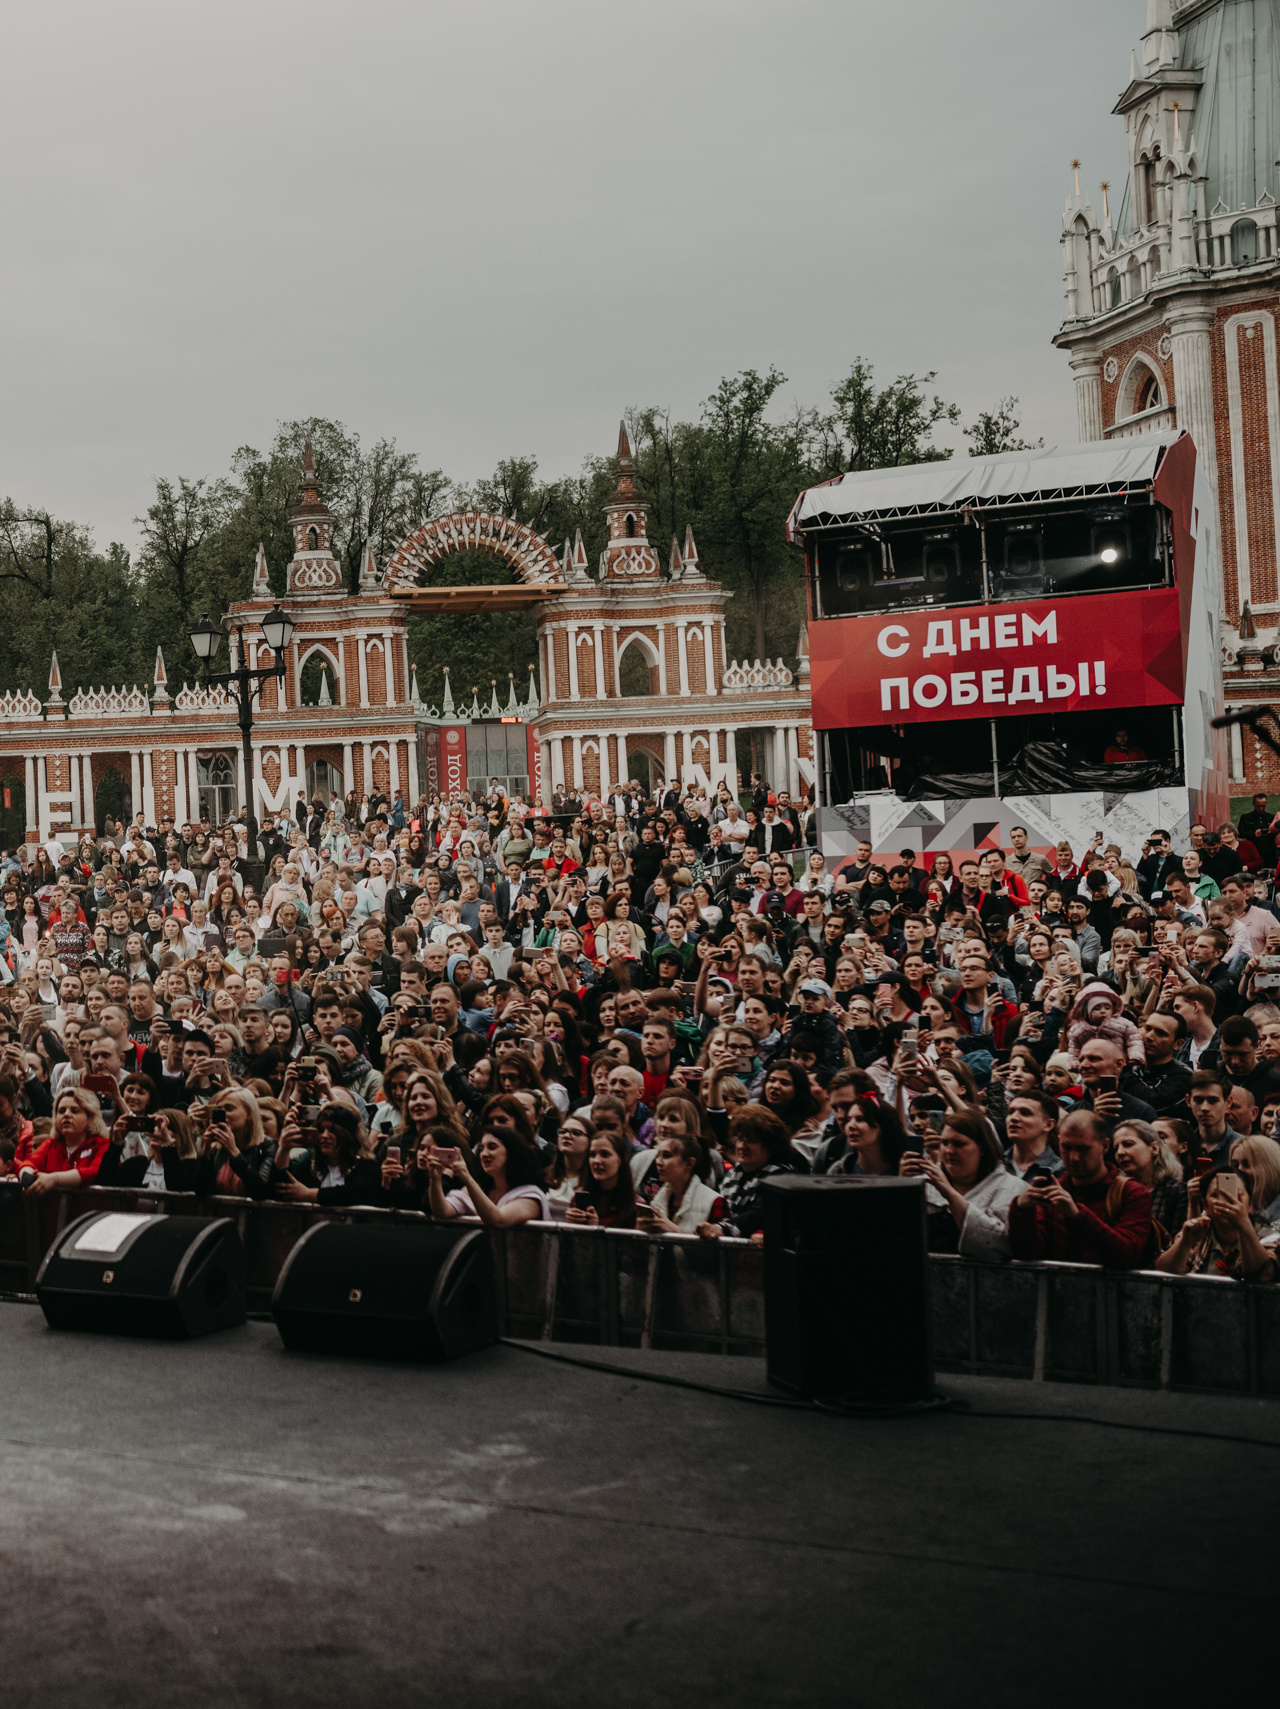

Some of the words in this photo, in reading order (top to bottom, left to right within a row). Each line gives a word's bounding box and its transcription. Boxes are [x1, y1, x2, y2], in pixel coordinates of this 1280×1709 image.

[876, 624, 911, 658] С
[922, 609, 1058, 659] ДНЕМ
[879, 660, 1108, 712] ПОБЕДЫ!
